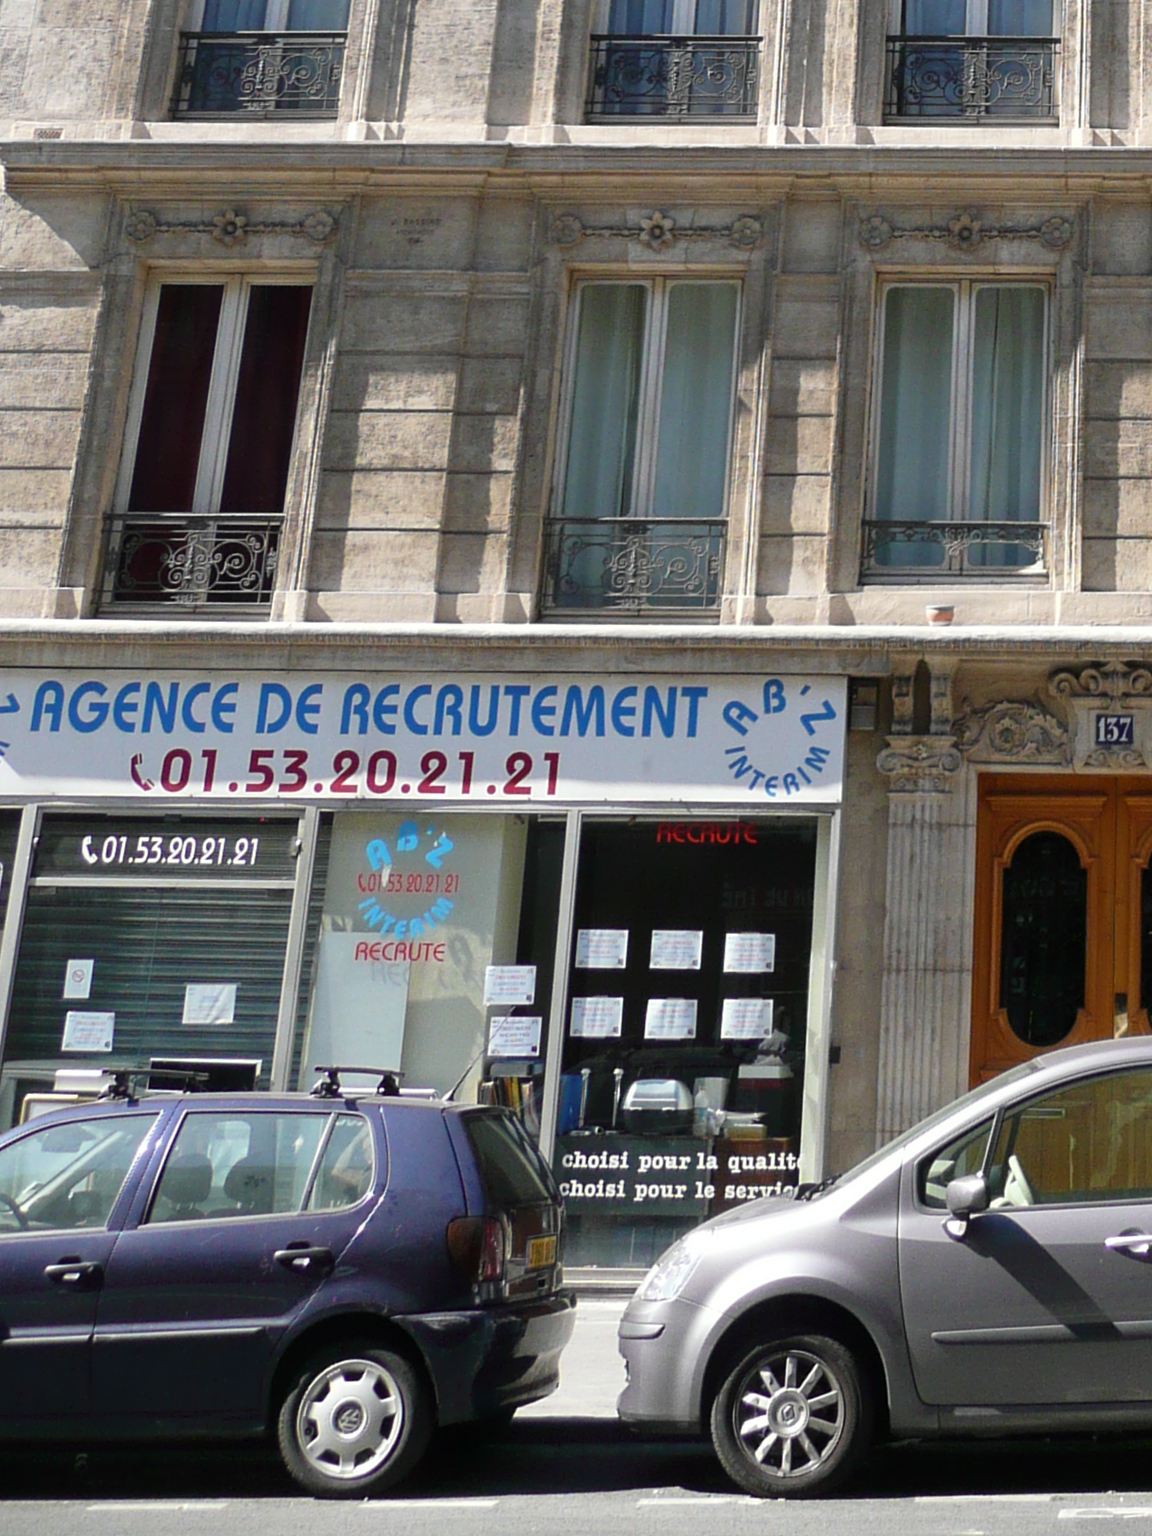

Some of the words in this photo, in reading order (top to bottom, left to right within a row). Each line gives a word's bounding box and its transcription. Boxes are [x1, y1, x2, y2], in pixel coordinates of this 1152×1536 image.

[30, 680, 239, 733] AGENCE
[255, 682, 324, 734] DE
[340, 683, 708, 738] RECRUTEMENT
[1098, 717, 1131, 742] 137
[160, 749, 560, 795] 01.53.20.21.21
[724, 746, 830, 796] INTERIM
[656, 821, 759, 844] RECRUTE
[101, 835, 259, 865] 01.53.20.21.21
[358, 896, 455, 939] INTERIM
[354, 941, 447, 962] RECRUTE
[562, 1151, 630, 1169] choisi
[637, 1154, 691, 1172] pour
[696, 1153, 719, 1170] la
[559, 1179, 626, 1198] choisi
[633, 1183, 687, 1201] pour
[695, 1181, 716, 1199] le
